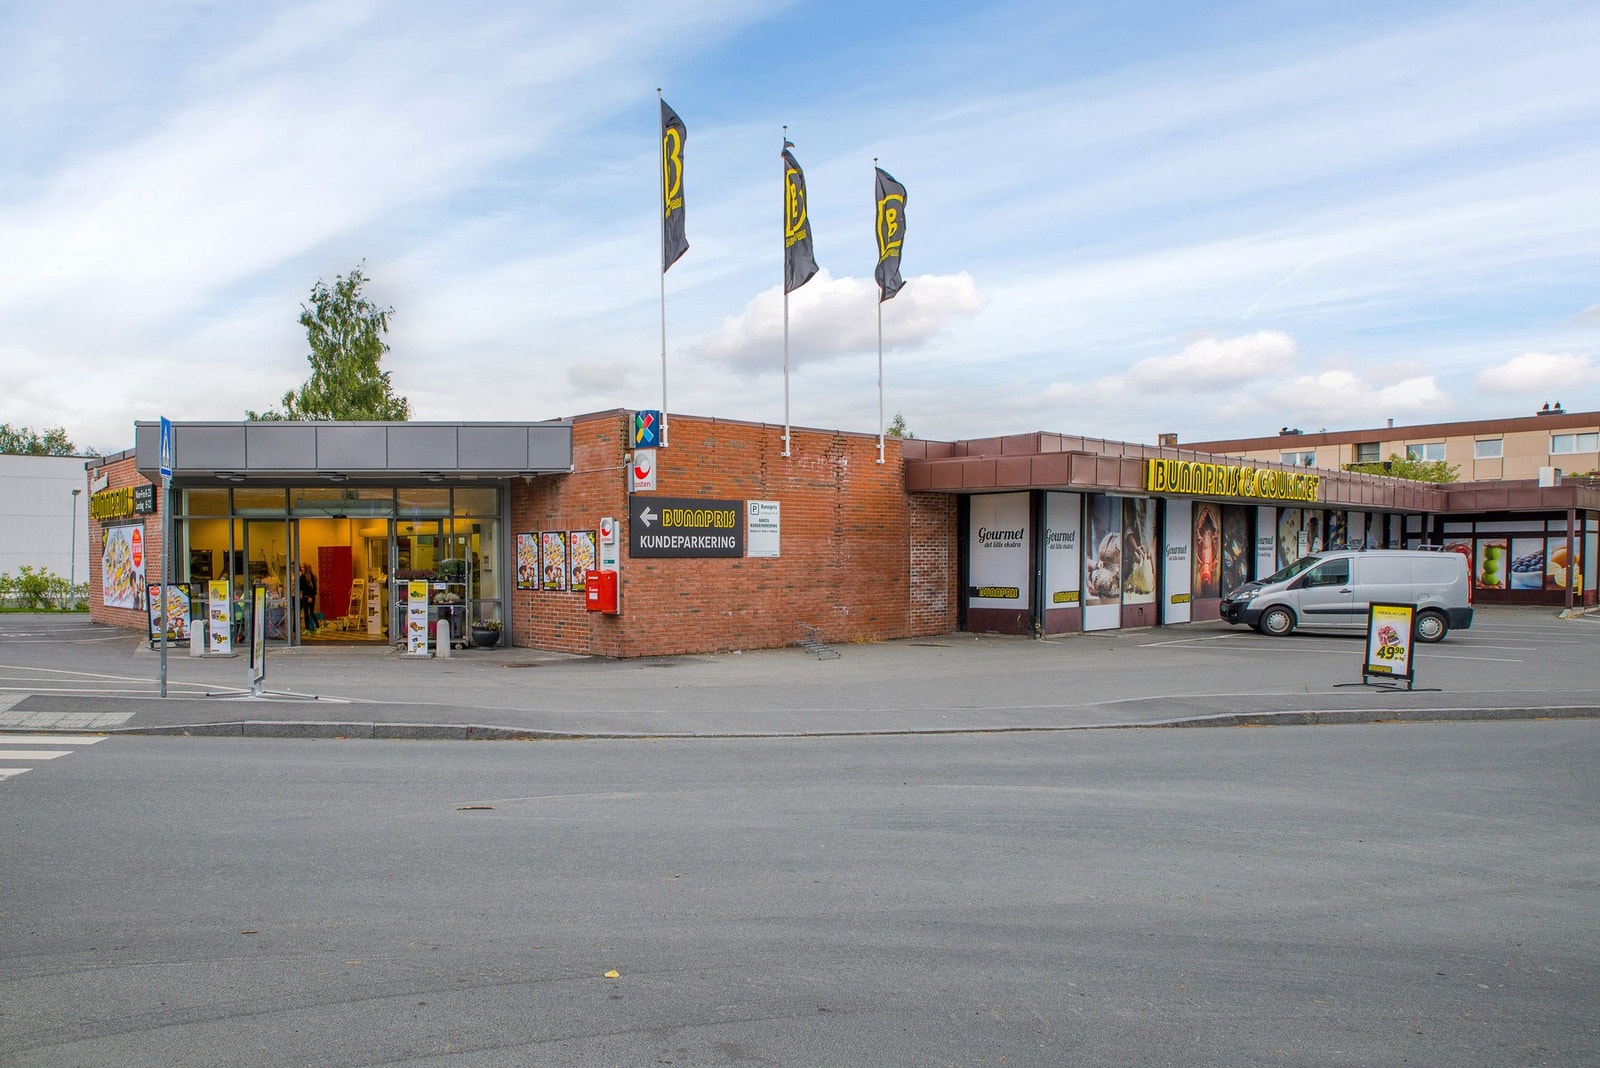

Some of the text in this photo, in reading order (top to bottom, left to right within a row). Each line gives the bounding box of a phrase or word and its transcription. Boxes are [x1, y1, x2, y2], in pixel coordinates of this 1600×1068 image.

[1149, 458, 1320, 501] BUNNPRIS & GOURMET
[662, 509, 736, 528] BUNNPRIS
[640, 535, 736, 549] KUNDEPARKERING
[978, 527, 1025, 544] Gourmet
[1046, 528, 1076, 545] Gourmet
